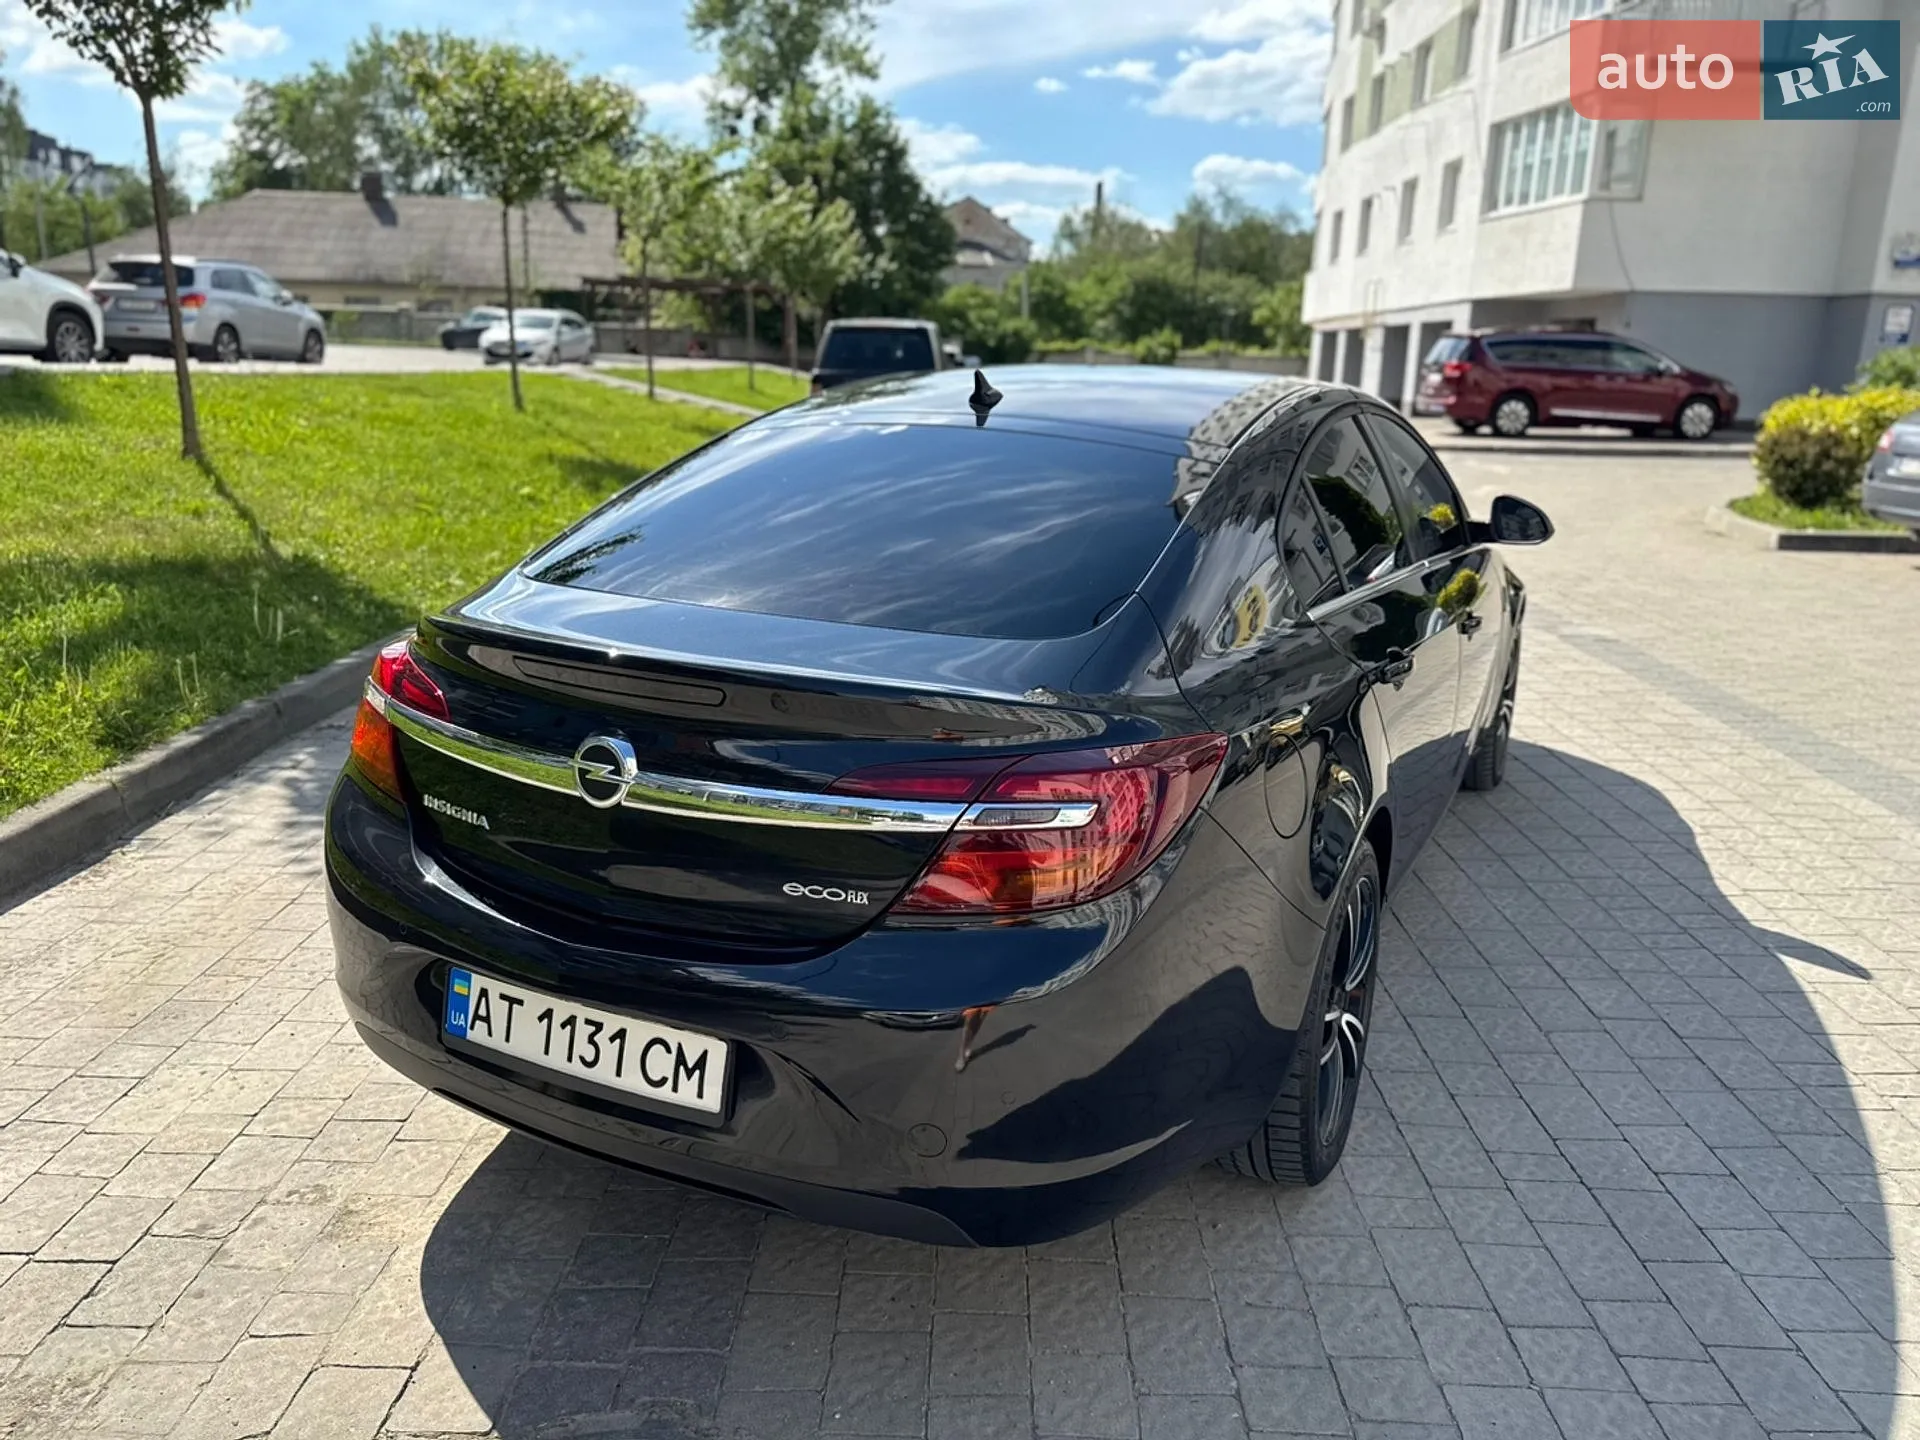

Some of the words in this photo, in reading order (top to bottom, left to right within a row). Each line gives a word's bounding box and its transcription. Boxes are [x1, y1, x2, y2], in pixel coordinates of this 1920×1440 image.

[423, 793, 490, 830] INSIGNIA
[450, 1013, 466, 1027] UA
[469, 987, 524, 1043] AT
[537, 1008, 628, 1078] 1131
[640, 1037, 709, 1100] CM
